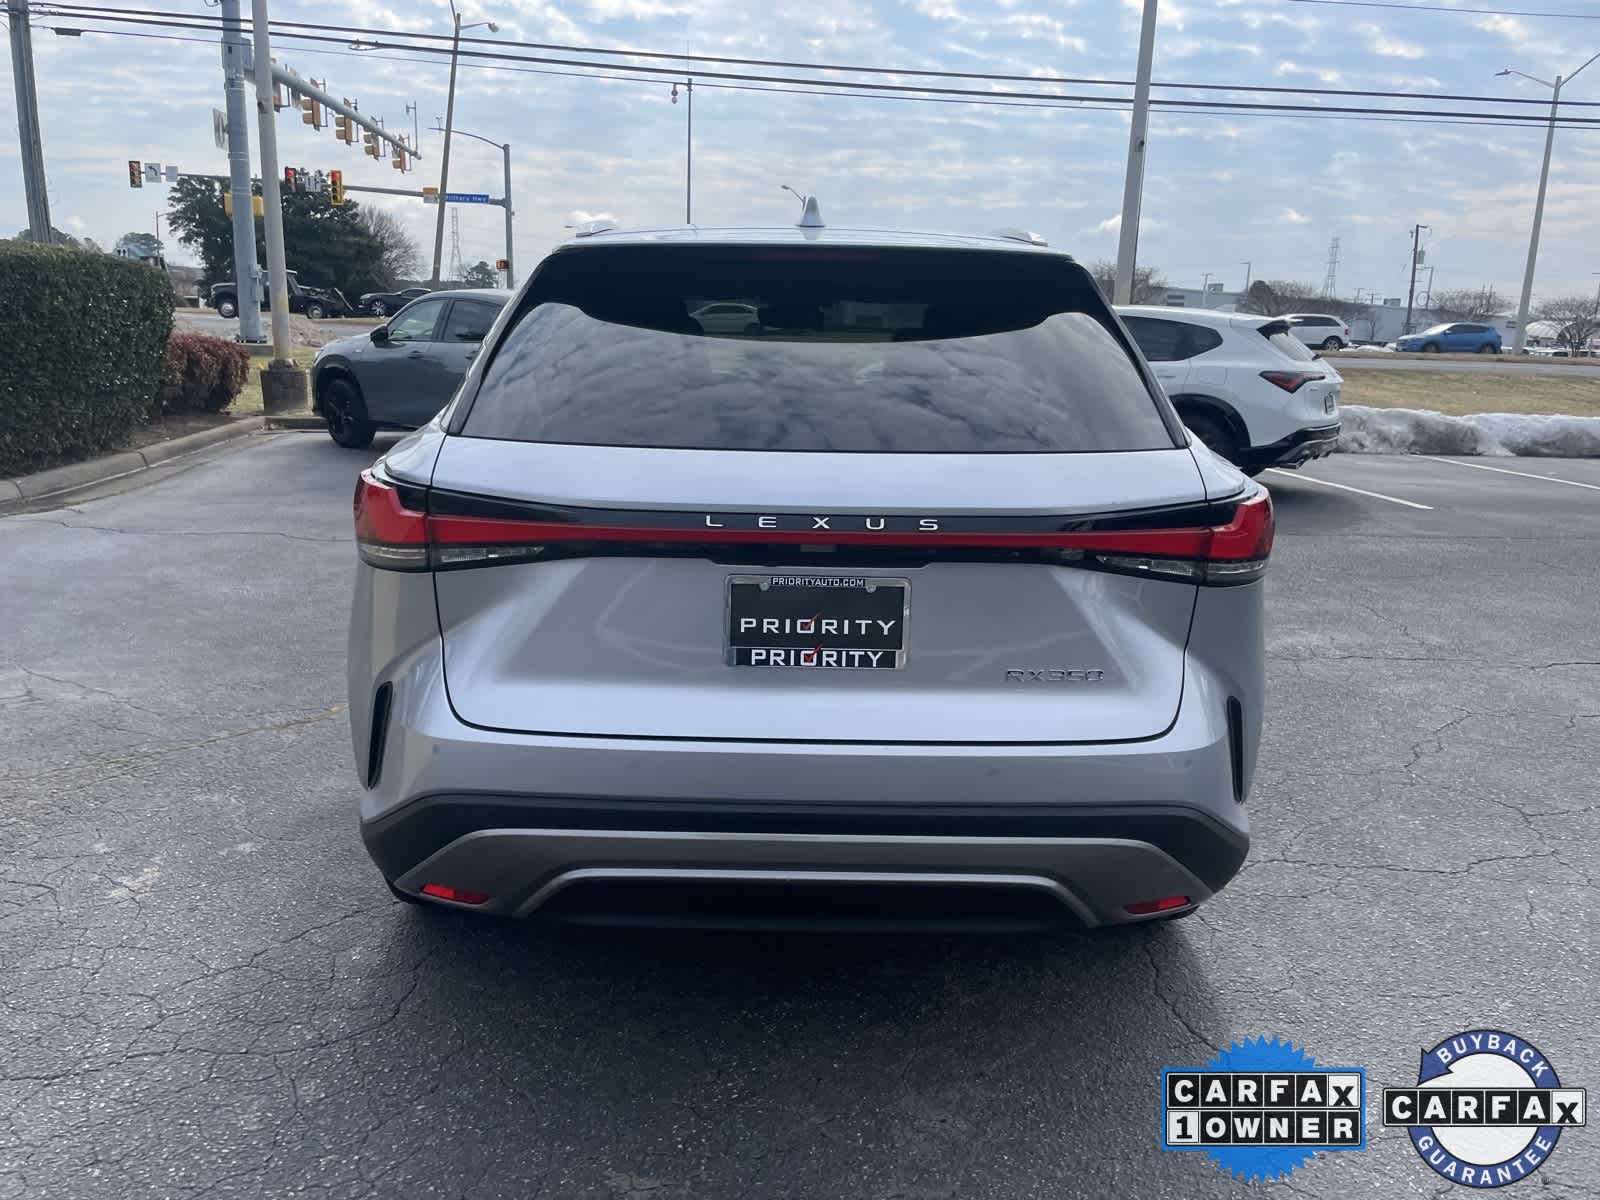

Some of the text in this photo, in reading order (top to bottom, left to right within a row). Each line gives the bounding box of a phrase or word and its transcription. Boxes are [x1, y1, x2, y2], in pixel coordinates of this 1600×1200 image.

[446, 194, 470, 202] ilitary
[705, 515, 939, 531] LEXUS
[772, 577, 864, 587] PRIORITYAUTO.COM
[740, 617, 896, 635] PRIORITY
[751, 649, 884, 667] PRIORITY
